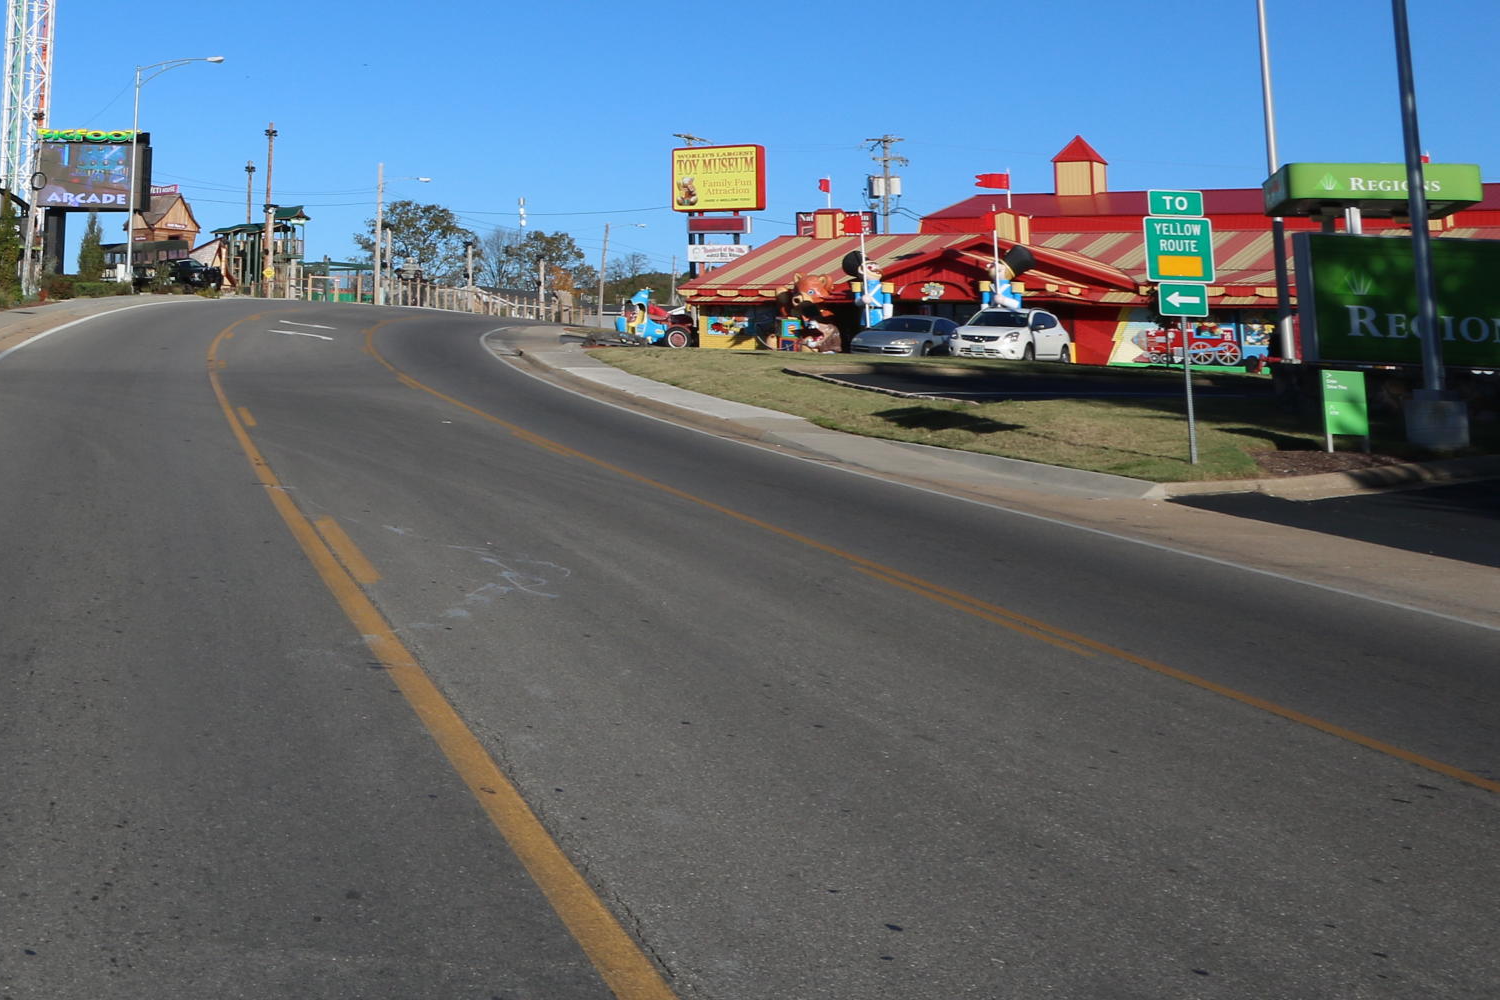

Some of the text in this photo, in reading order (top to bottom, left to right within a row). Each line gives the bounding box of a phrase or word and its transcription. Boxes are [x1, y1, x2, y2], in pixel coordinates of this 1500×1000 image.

[677, 157, 754, 175] TOY MUSEUM
[703, 179, 751, 188] Family Fun
[706, 187, 749, 195] Attraction
[47, 192, 126, 205] ARCADE
[1162, 196, 1188, 211] TO
[1154, 222, 1201, 236] YELLOW
[1159, 239, 1199, 252] ROUTE
